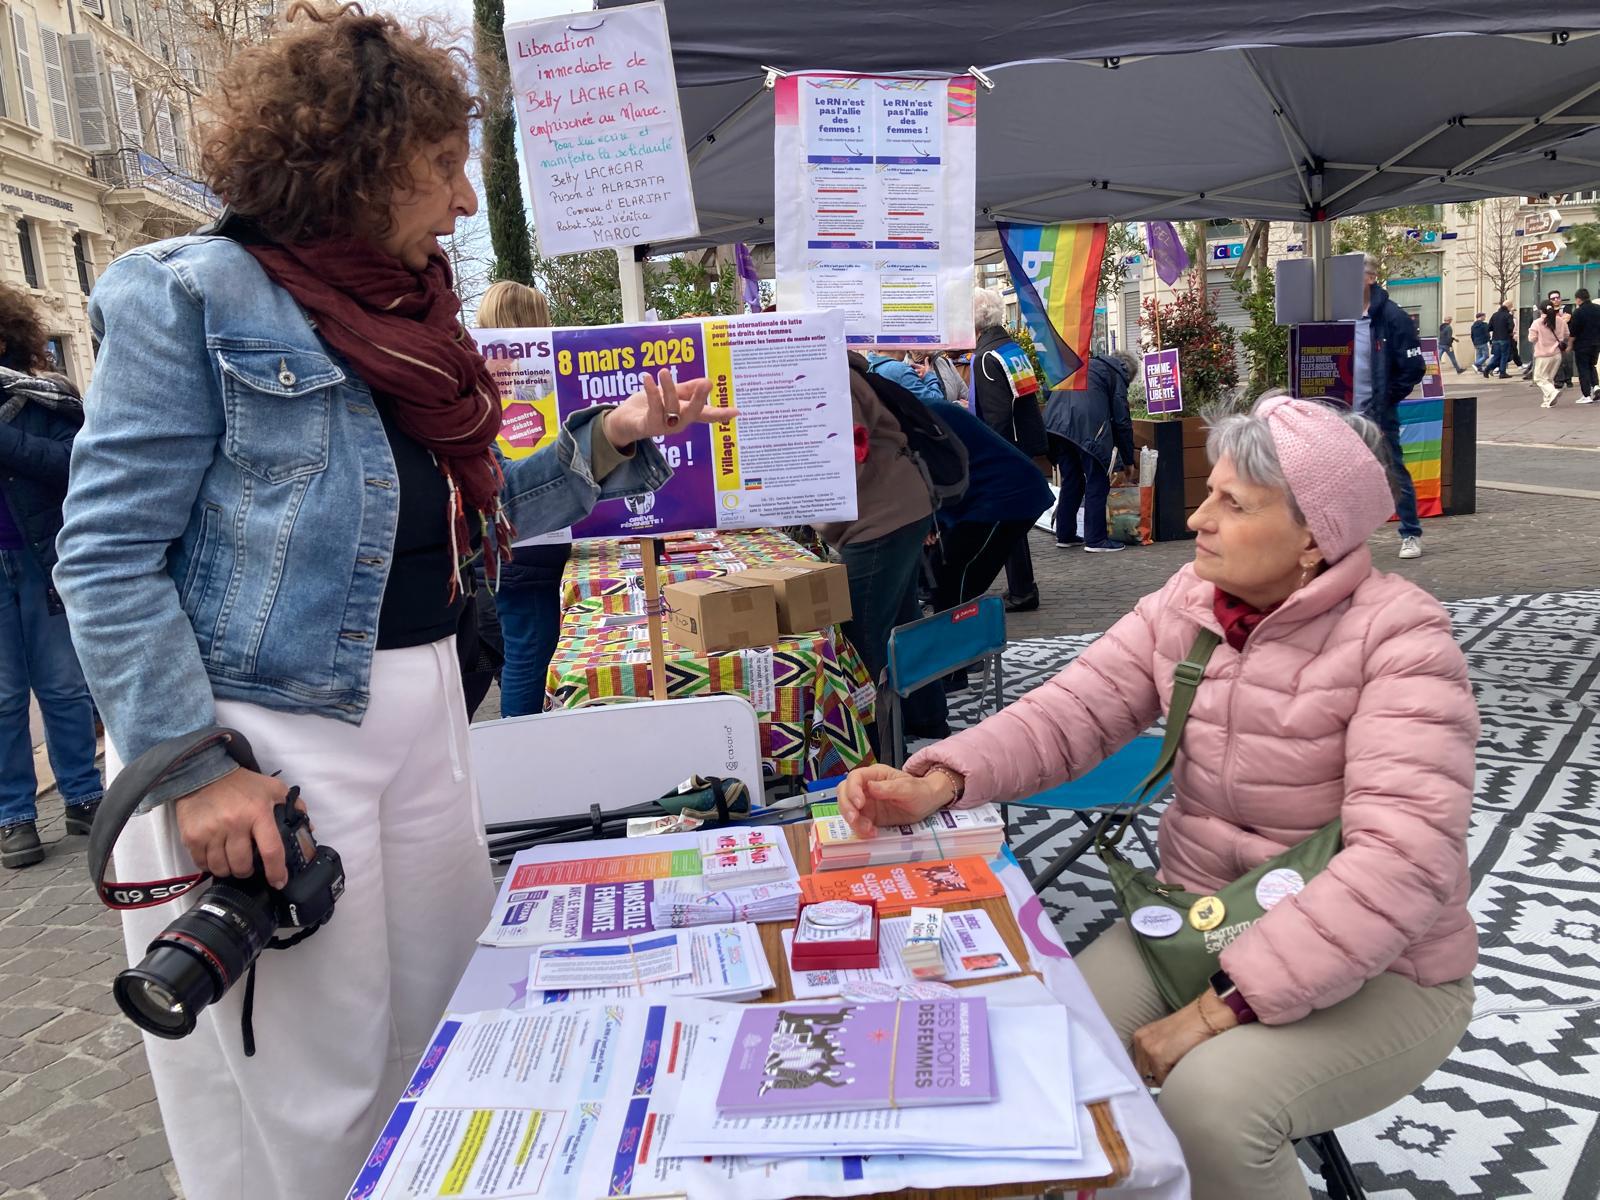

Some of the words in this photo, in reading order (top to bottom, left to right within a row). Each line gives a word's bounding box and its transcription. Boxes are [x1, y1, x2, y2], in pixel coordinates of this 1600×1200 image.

[626, 51, 648, 68] de
[526, 90, 562, 114] Betty
[815, 98, 826, 106] Le
[826, 98, 840, 106] RN
[842, 98, 865, 106] n'est
[883, 99, 894, 107] Le
[894, 99, 909, 107] RN
[910, 99, 933, 107] n'est
[599, 115, 616, 124] au
[819, 107, 836, 117] pas
[887, 108, 904, 118] pas
[832, 116, 849, 124] des
[900, 117, 917, 125] des
[640, 126, 649, 136] et
[819, 125, 855, 134] femmes
[857, 125, 861, 134] !
[887, 126, 923, 135] femmes
[925, 126, 929, 135] !
[551, 171, 580, 193] Betty
[593, 226, 642, 242] MAROC
[1217, 246, 1241, 257] CIC
[736, 320, 778, 328] internationale
[712, 331, 727, 339] pour
[727, 330, 736, 338] les
[737, 329, 755, 337] droits
[756, 328, 767, 336] des
[768, 327, 792, 335] femmes
[481, 341, 551, 360] mars
[557, 350, 573, 376] 8
[578, 347, 636, 374] mars
[641, 337, 695, 366] 2026
[496, 369, 551, 377] internationale
[1147, 362, 1172, 375] FEMME,
[514, 378, 524, 386] les
[525, 376, 547, 385] droits
[1148, 377, 1161, 388] VIE,
[1149, 385, 1175, 400] LIBERTÉ
[716, 374, 731, 432] Finiste
[501, 410, 537, 426] Rencontres
[508, 426, 543, 440] animations
[721, 435, 735, 475] Village
[149, 881, 194, 899] OS
[850, 882, 867, 897] LES
[862, 872, 886, 901] DROITS
[880, 878, 898, 894] DES
[891, 867, 918, 900] FEMMES
[113, 889, 145, 904] 6D
[568, 886, 581, 900] AVEC
[550, 895, 566, 929] MARSEILLAIS
[592, 886, 621, 934] FÉMINISTE
[623, 882, 647, 931] MARSEILLE
[564, 906, 580, 938] PRINTEMPS
[918, 1004, 935, 1026] DES
[938, 1002, 955, 1028] DES
[915, 1028, 934, 1089] FEMMES
[937, 1032, 956, 1089] DROITS
